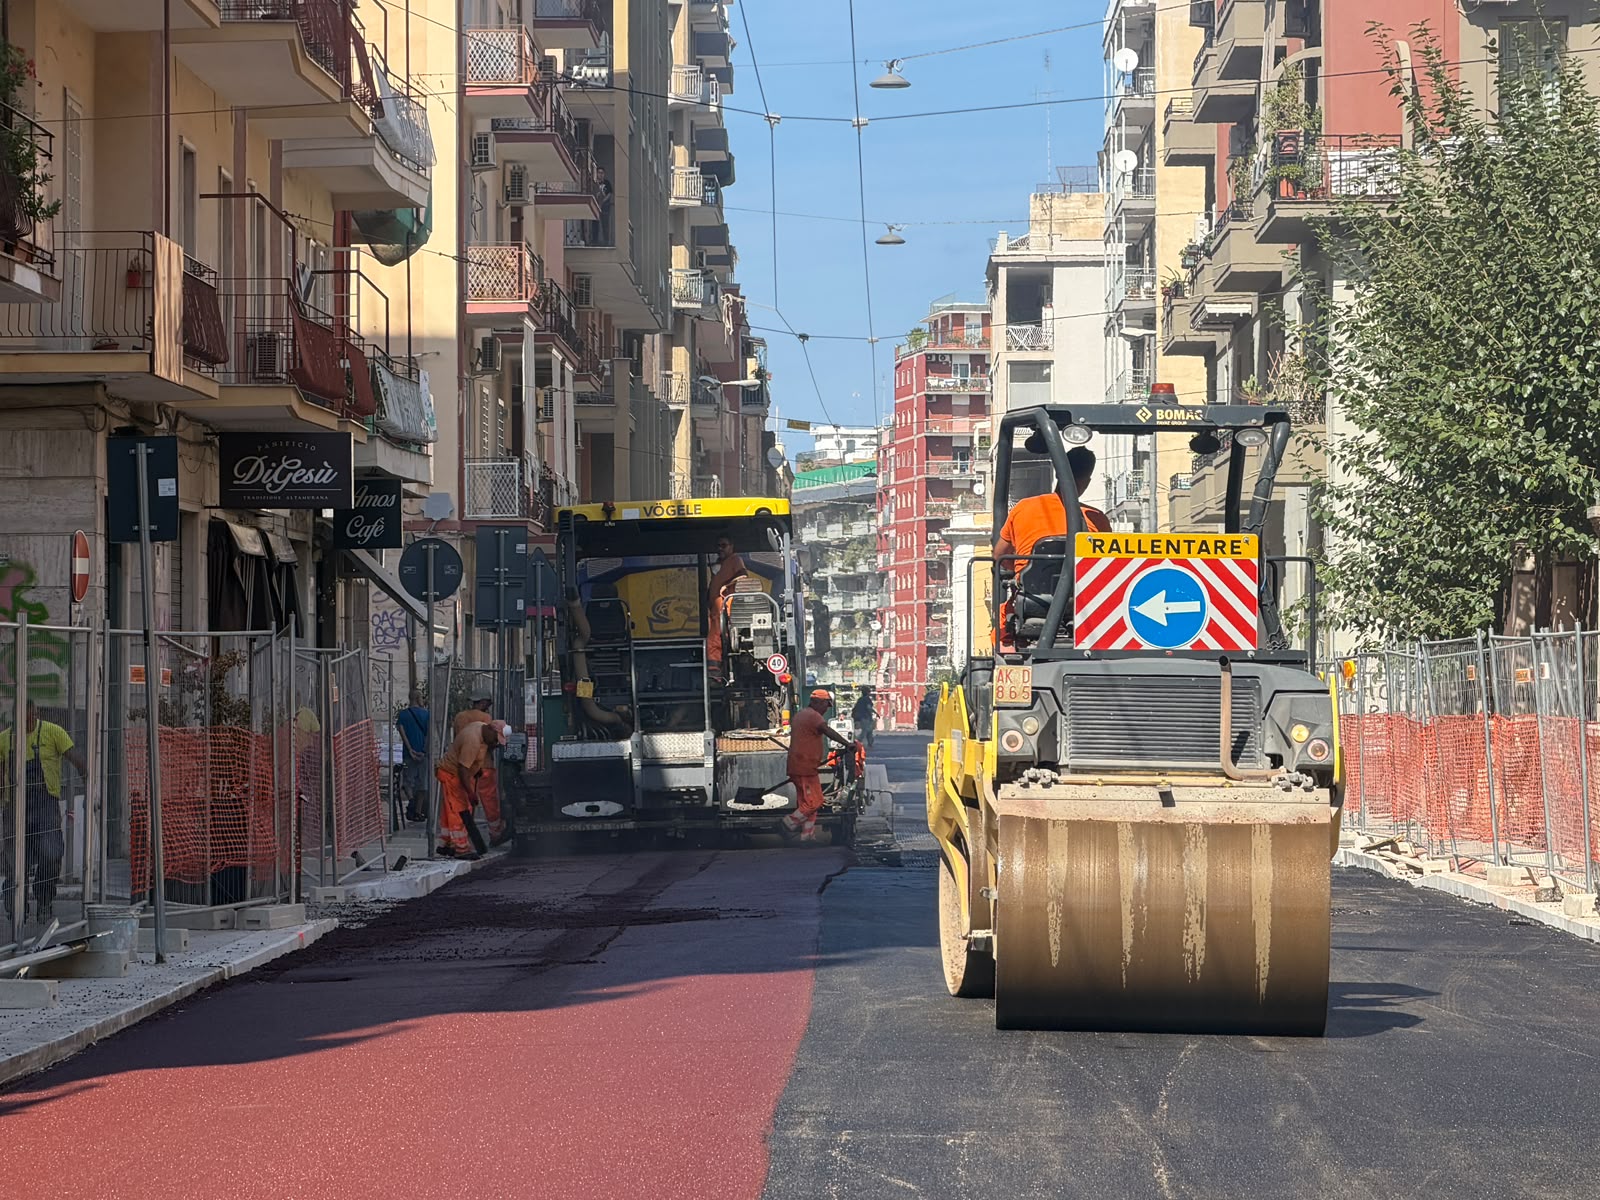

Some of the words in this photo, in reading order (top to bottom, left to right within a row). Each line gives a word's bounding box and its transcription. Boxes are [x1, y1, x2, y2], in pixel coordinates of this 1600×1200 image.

[257, 441, 316, 452] PANIFICIO
[354, 485, 396, 508] Amos
[643, 502, 702, 517] VÖGELE
[1092, 538, 1243, 555] RALLENTARE
[772, 658, 782, 667] 40
[997, 669, 1014, 683] AK
